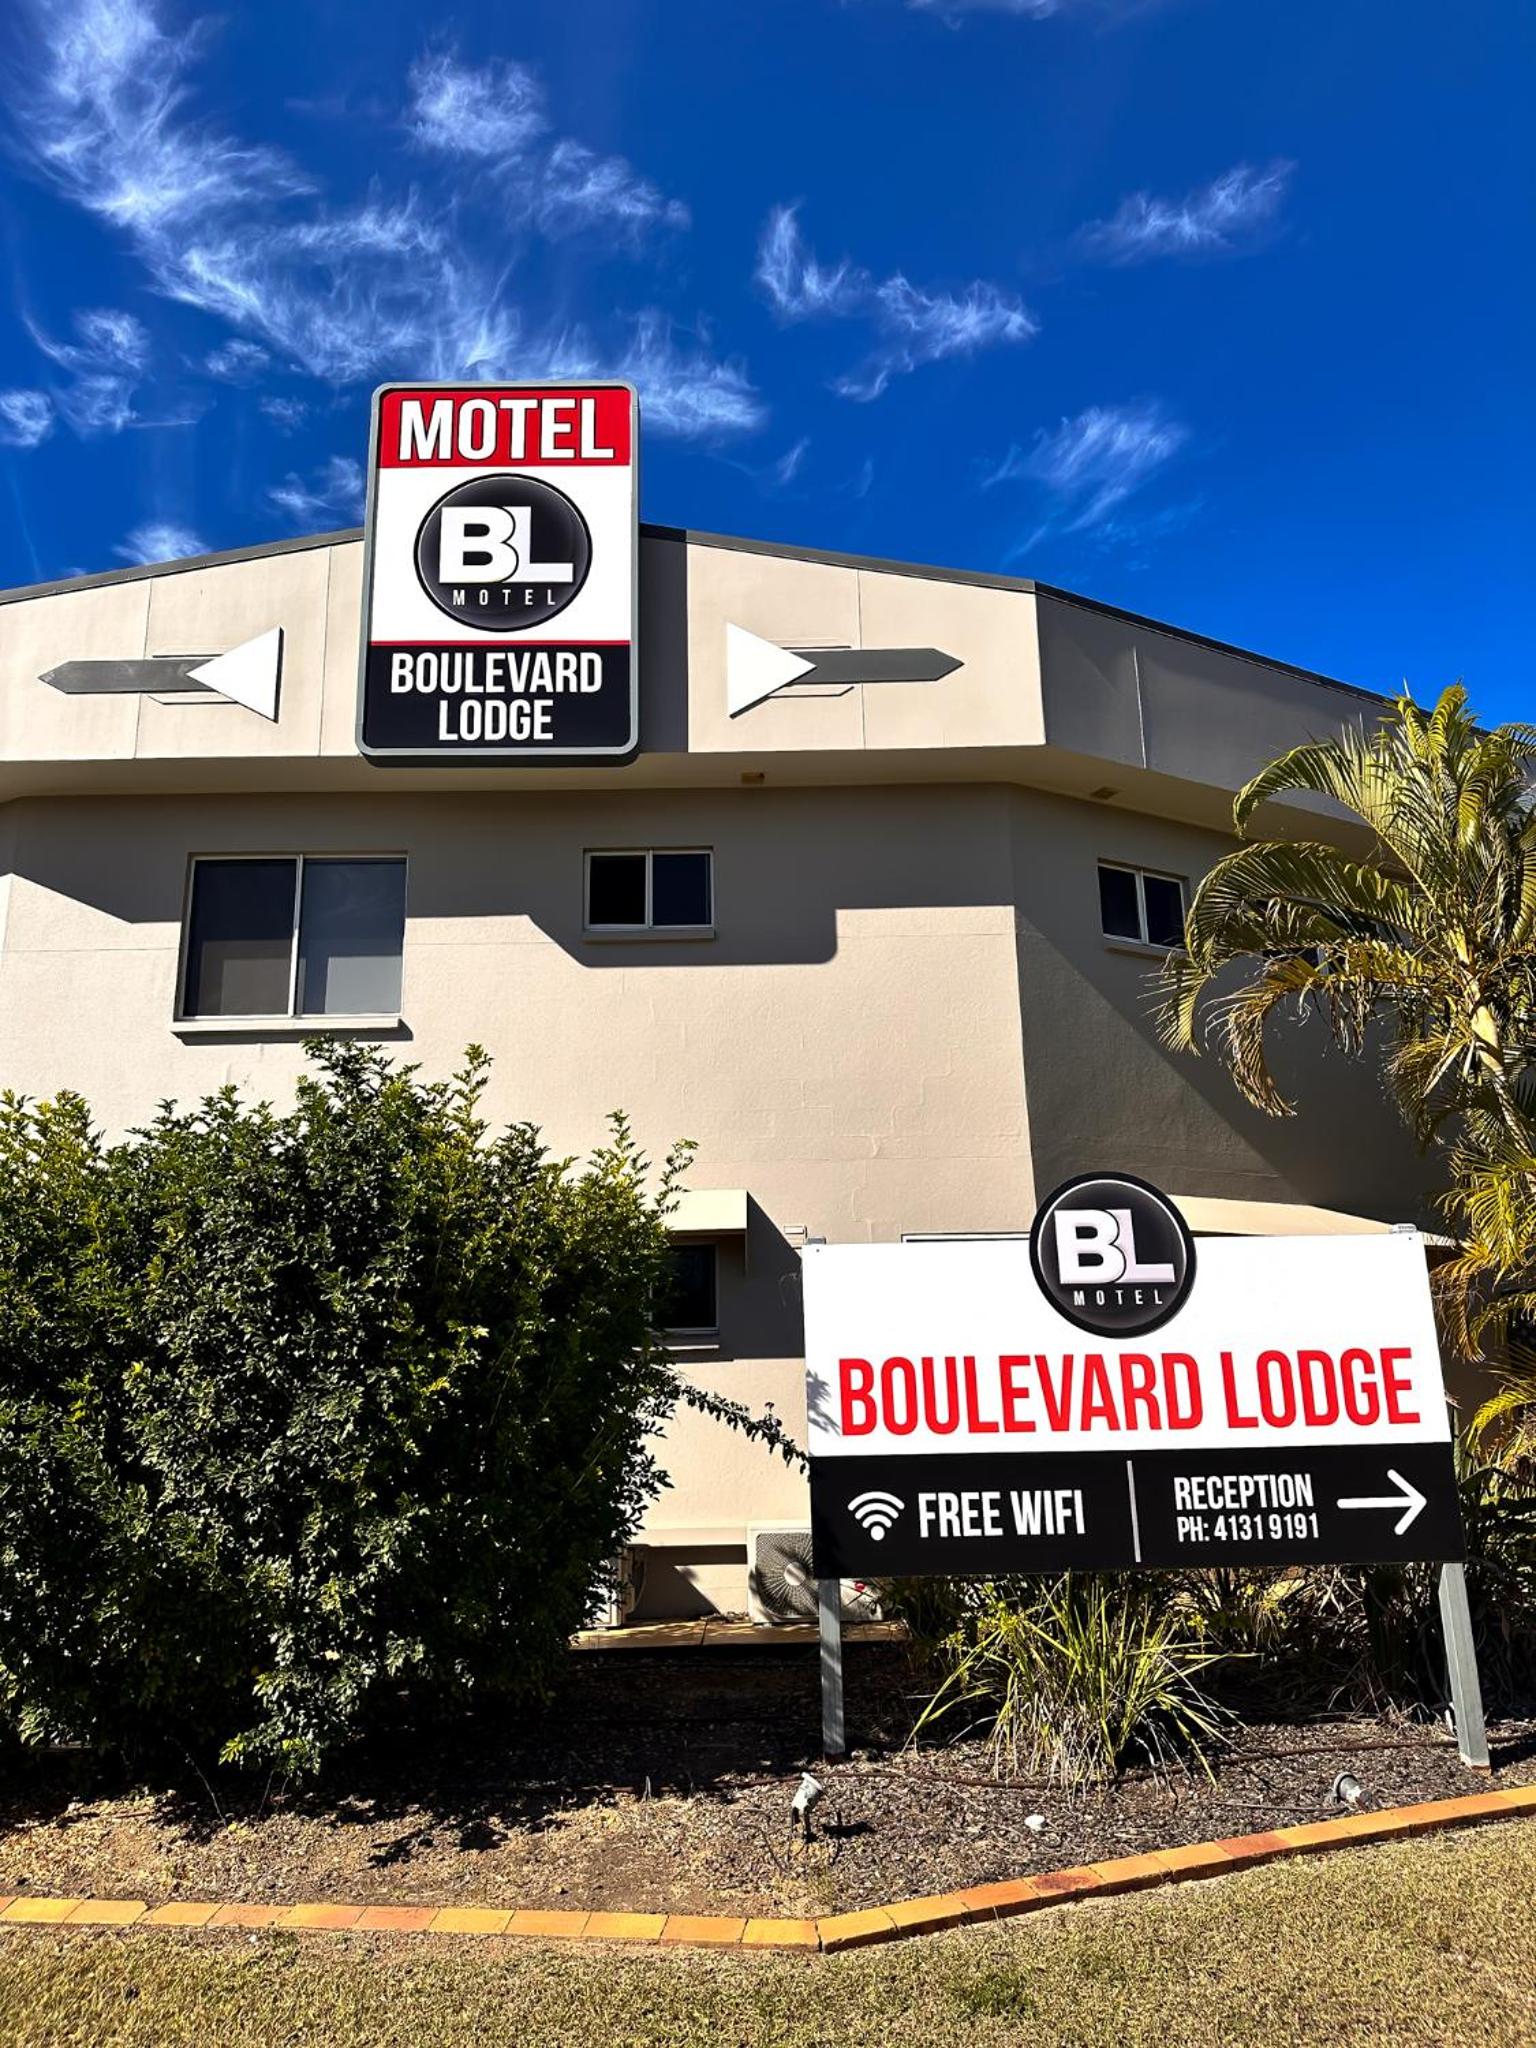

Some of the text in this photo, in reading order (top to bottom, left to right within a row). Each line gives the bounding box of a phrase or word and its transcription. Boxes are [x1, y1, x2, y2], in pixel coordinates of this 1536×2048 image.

[400, 398, 614, 460] MOTEL
[439, 506, 573, 583] BL
[453, 589, 555, 605] MOTEL
[391, 652, 602, 693] BOULEVARD
[438, 699, 554, 741] LODGE
[1053, 1208, 1175, 1284] BL
[1073, 1289, 1163, 1306] MOTEL
[838, 1347, 1420, 1436] BOULEVARD LODGE
[1173, 1473, 1314, 1511] RECEPTION
[918, 1489, 1085, 1538] FREE WIFI
[1176, 1513, 1320, 1543] PH: 4131 9191
